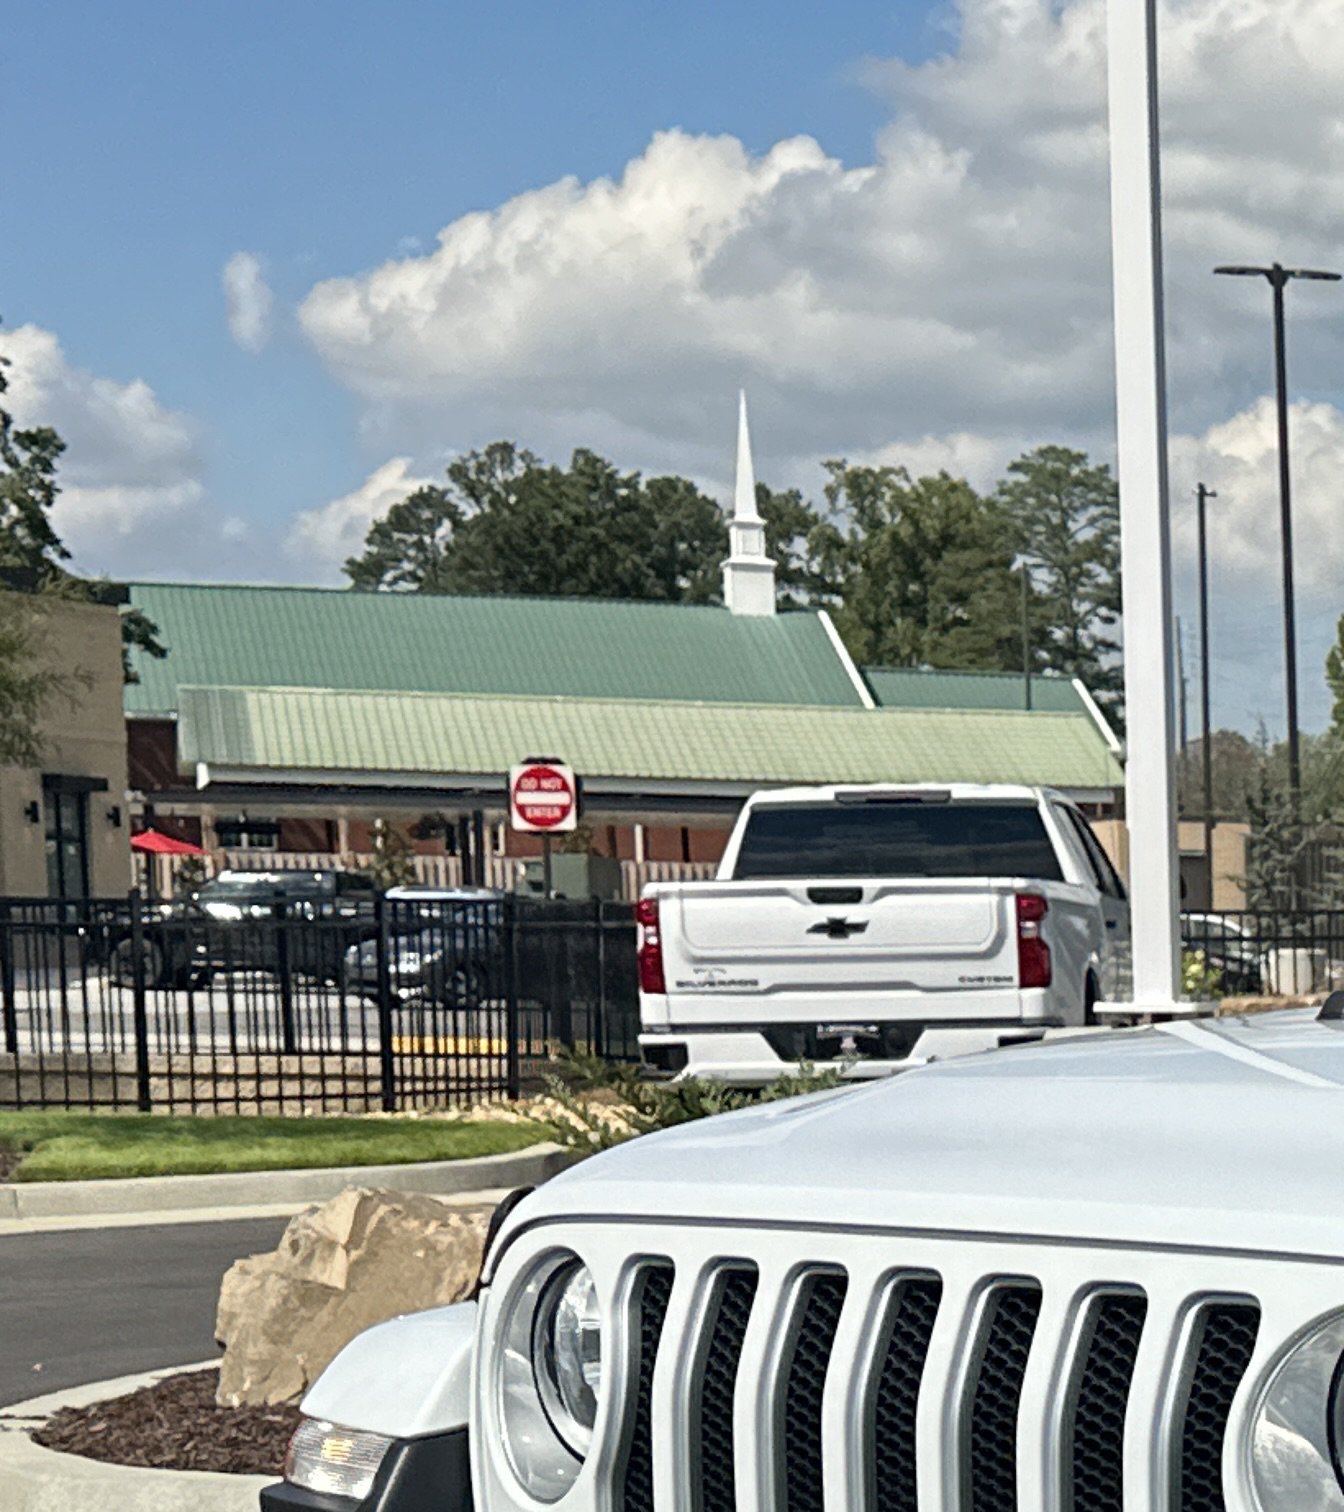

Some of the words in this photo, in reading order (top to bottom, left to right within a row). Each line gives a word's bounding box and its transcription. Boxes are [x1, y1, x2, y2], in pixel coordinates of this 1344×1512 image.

[520, 776, 539, 791] DO
[540, 776, 564, 791] NOT
[525, 805, 563, 819] ENTER
